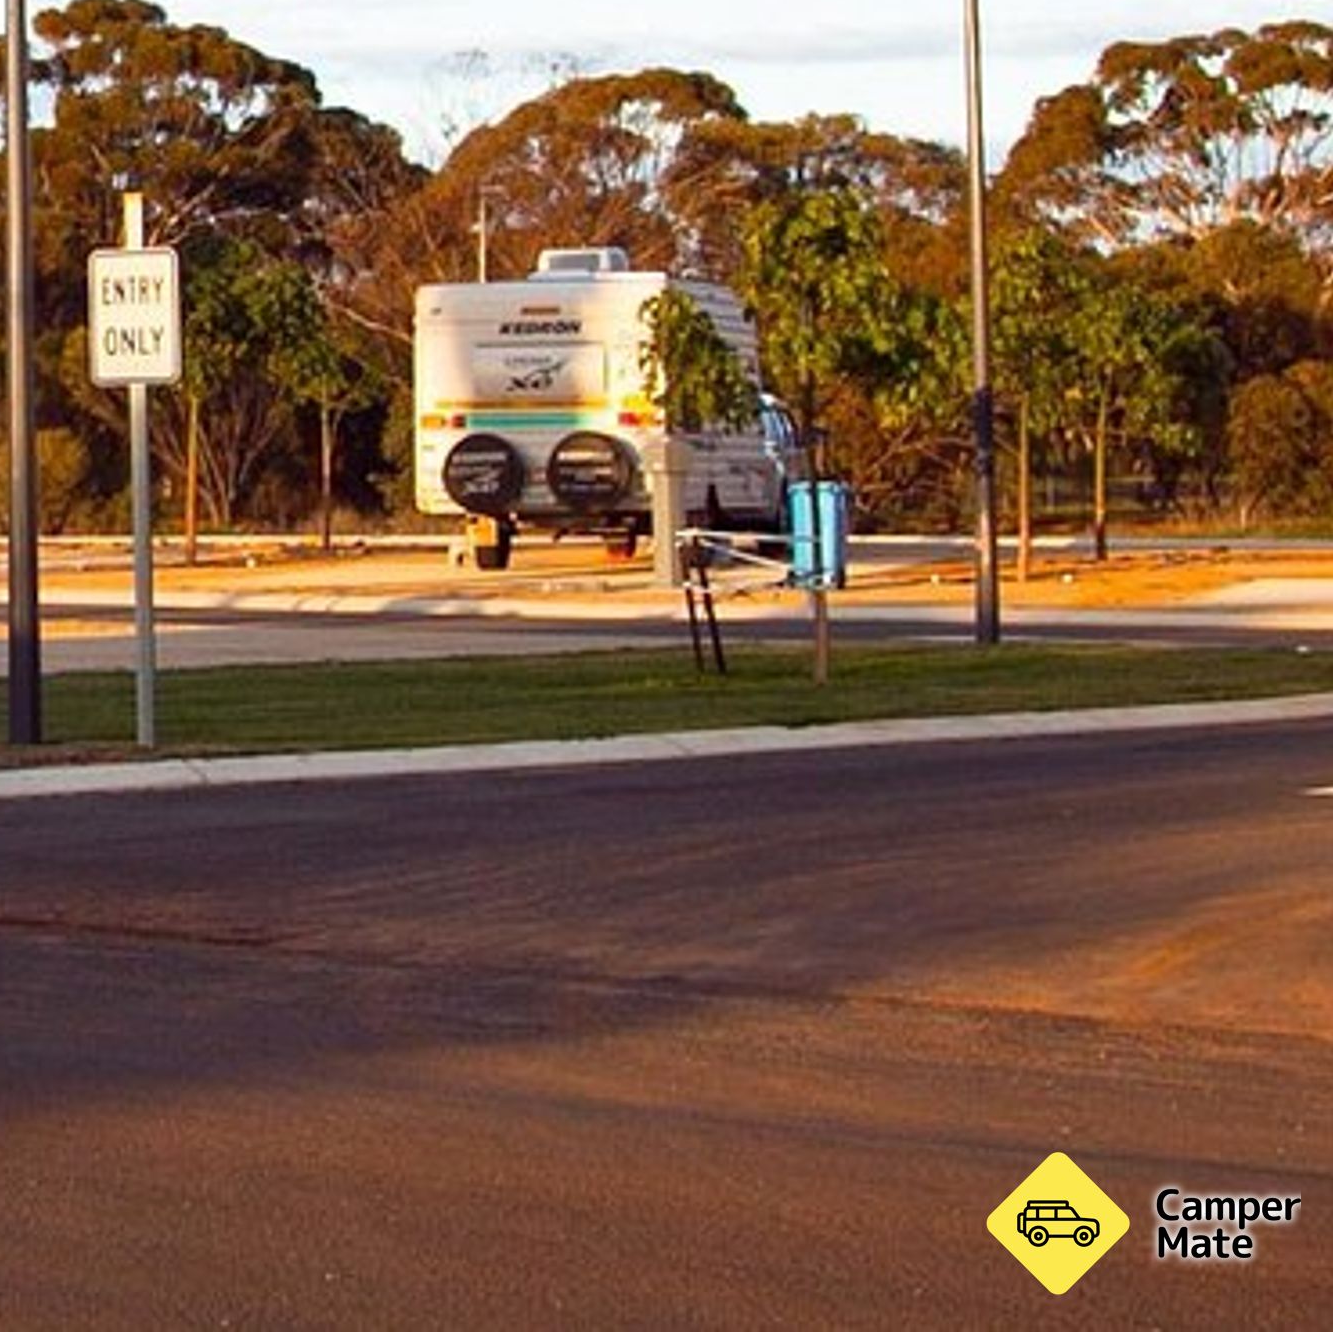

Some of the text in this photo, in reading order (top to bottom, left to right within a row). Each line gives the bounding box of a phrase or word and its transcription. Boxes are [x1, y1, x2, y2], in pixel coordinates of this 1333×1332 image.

[101, 276, 164, 306] ENTRY
[103, 326, 165, 356] ONLY
[498, 319, 582, 335] KEDRON
